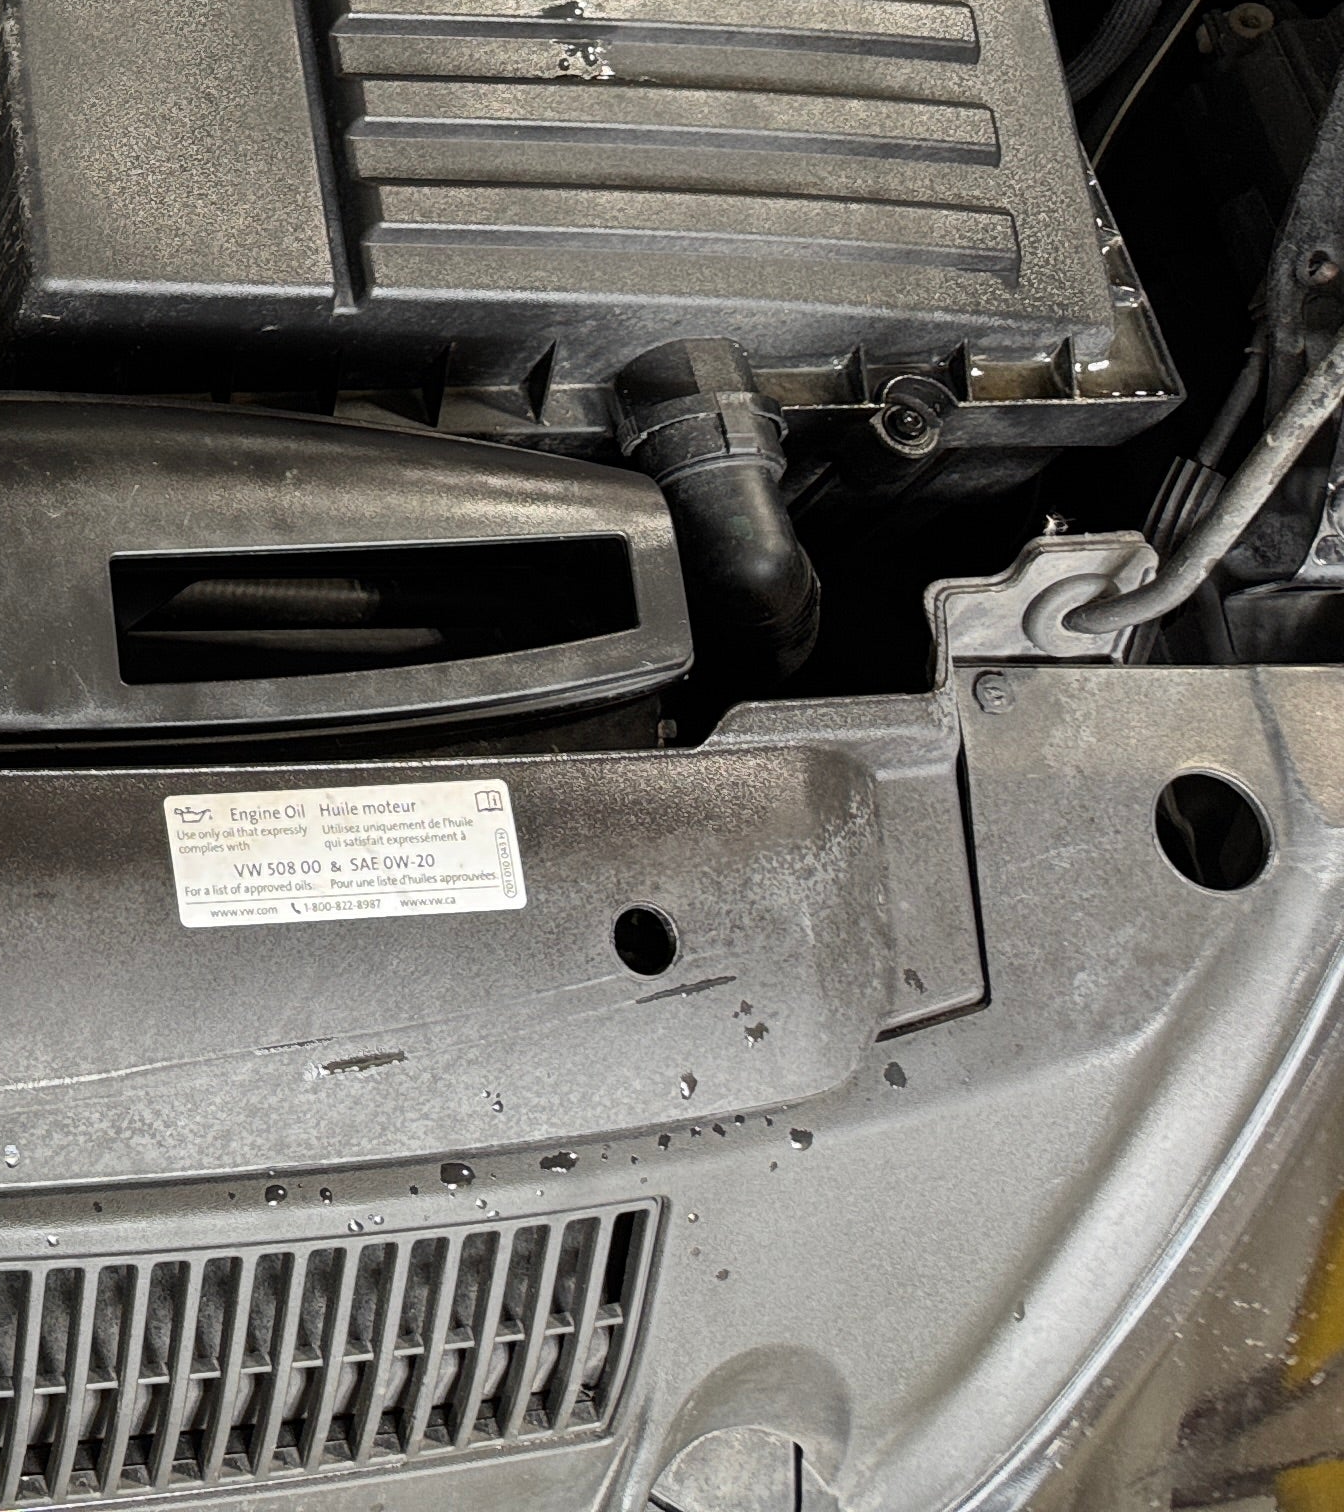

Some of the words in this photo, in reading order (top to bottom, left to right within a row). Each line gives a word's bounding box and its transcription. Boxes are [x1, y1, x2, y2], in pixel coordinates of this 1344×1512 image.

[230, 808, 281, 825] Engine
[285, 804, 306, 819] Oil
[319, 802, 358, 817] Huile
[362, 801, 416, 816] moteur
[177, 830, 196, 840] Use
[198, 829, 220, 842] only
[223, 828, 235, 838] oil
[237, 827, 258, 837] that
[260, 825, 307, 838] expressly
[322, 824, 360, 835] Utilisez
[363, 820, 426, 834] uniquement
[428, 819, 440, 829] de
[443, 817, 473, 828] l'huile
[178, 843, 224, 856] complies
[227, 841, 250, 852] with
[325, 839, 341, 850] qui
[344, 836, 384, 847] satisfait
[387, 833, 458, 846] expressément
[460, 831, 466, 841] à
[234, 863, 262, 878] VW
[268, 861, 296, 876] 508
[300, 860, 322, 874] 00
[330, 860, 342, 872] &
[350, 856, 378, 872] SAE
[383, 854, 435, 870] 0W-20
[185, 886, 201, 897] For
[204, 888, 210, 896] a
[212, 884, 228, 896] list
[230, 884, 241, 894] of
[243, 882, 292, 896] approved
[330, 878, 354, 889] Pour
[356, 877, 374, 887] une
[377, 876, 397, 886] liste
[399, 874, 437, 885] d'huiles
[210, 906, 278, 917] www.vw.com
[304, 898, 381, 912] 1-800-822-8987
[399, 896, 456, 908] www.vw.ca
